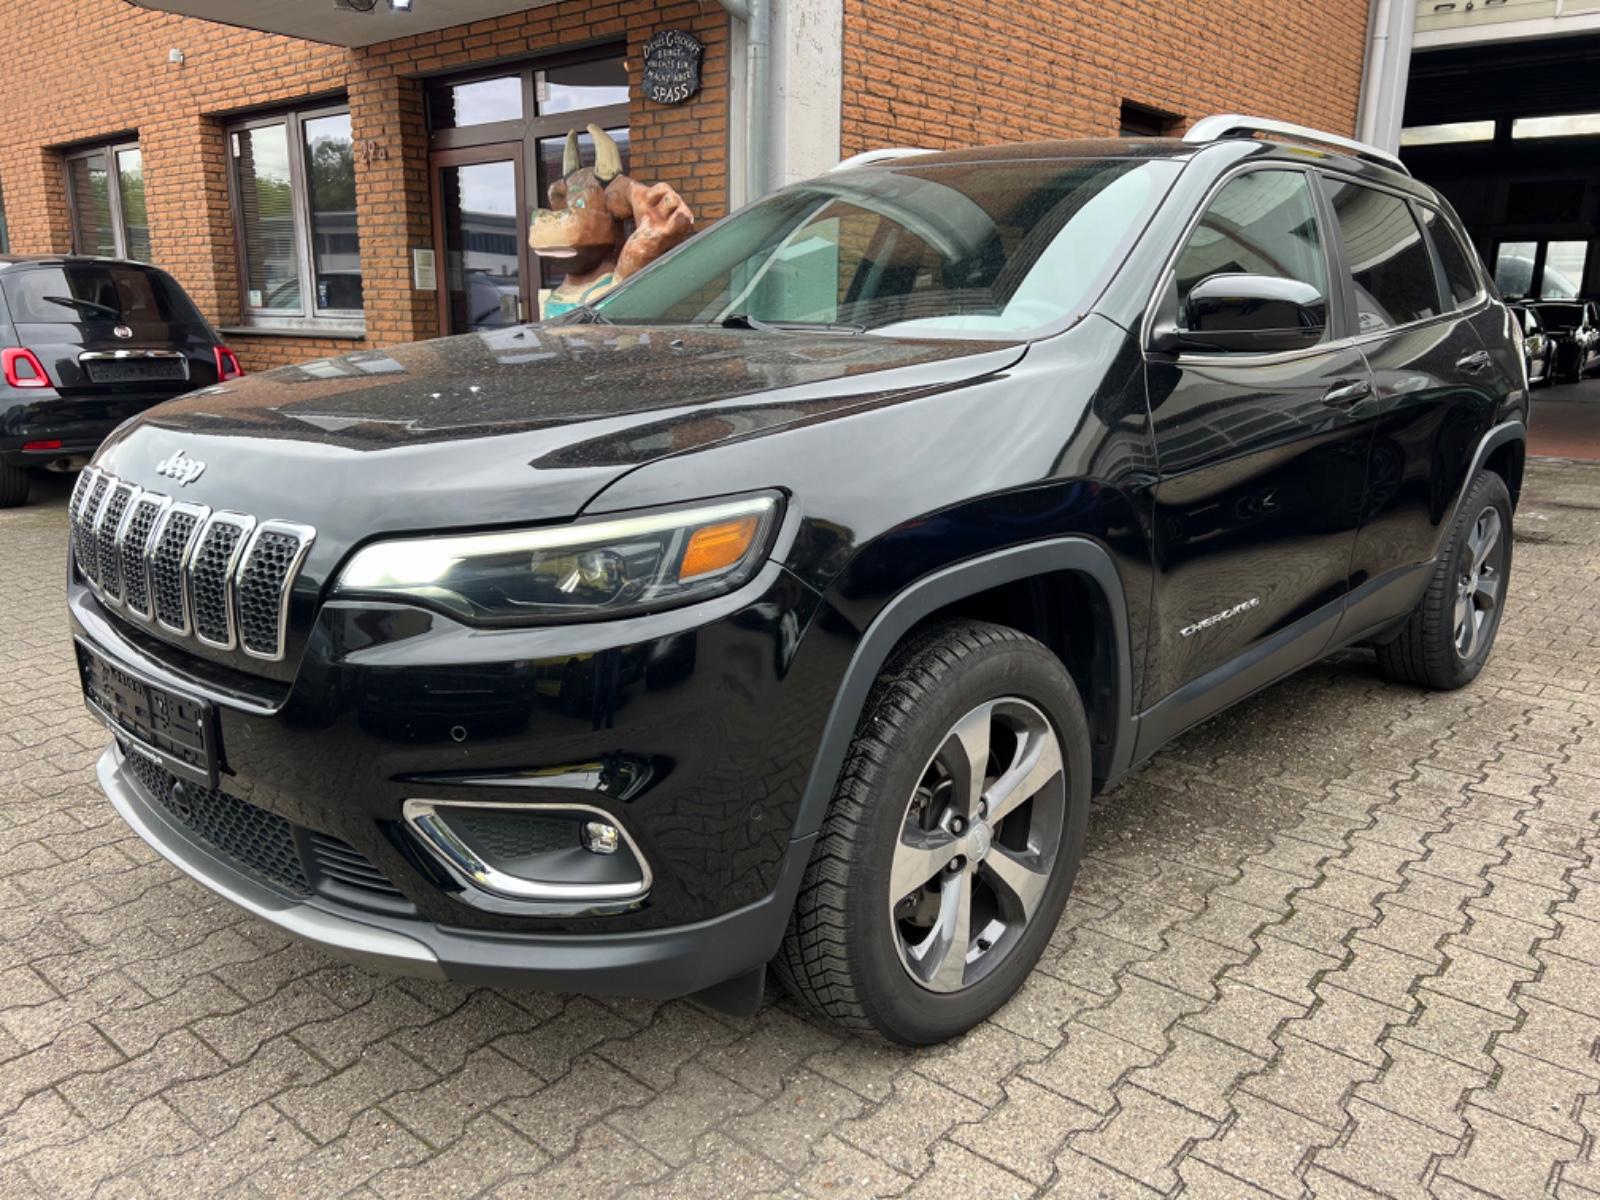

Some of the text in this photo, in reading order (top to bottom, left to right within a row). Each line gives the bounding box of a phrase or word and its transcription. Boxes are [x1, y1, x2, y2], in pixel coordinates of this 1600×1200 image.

[652, 83, 689, 102] SPASS
[156, 449, 207, 488] Jeep
[1180, 597, 1260, 637] CHEROKEE
